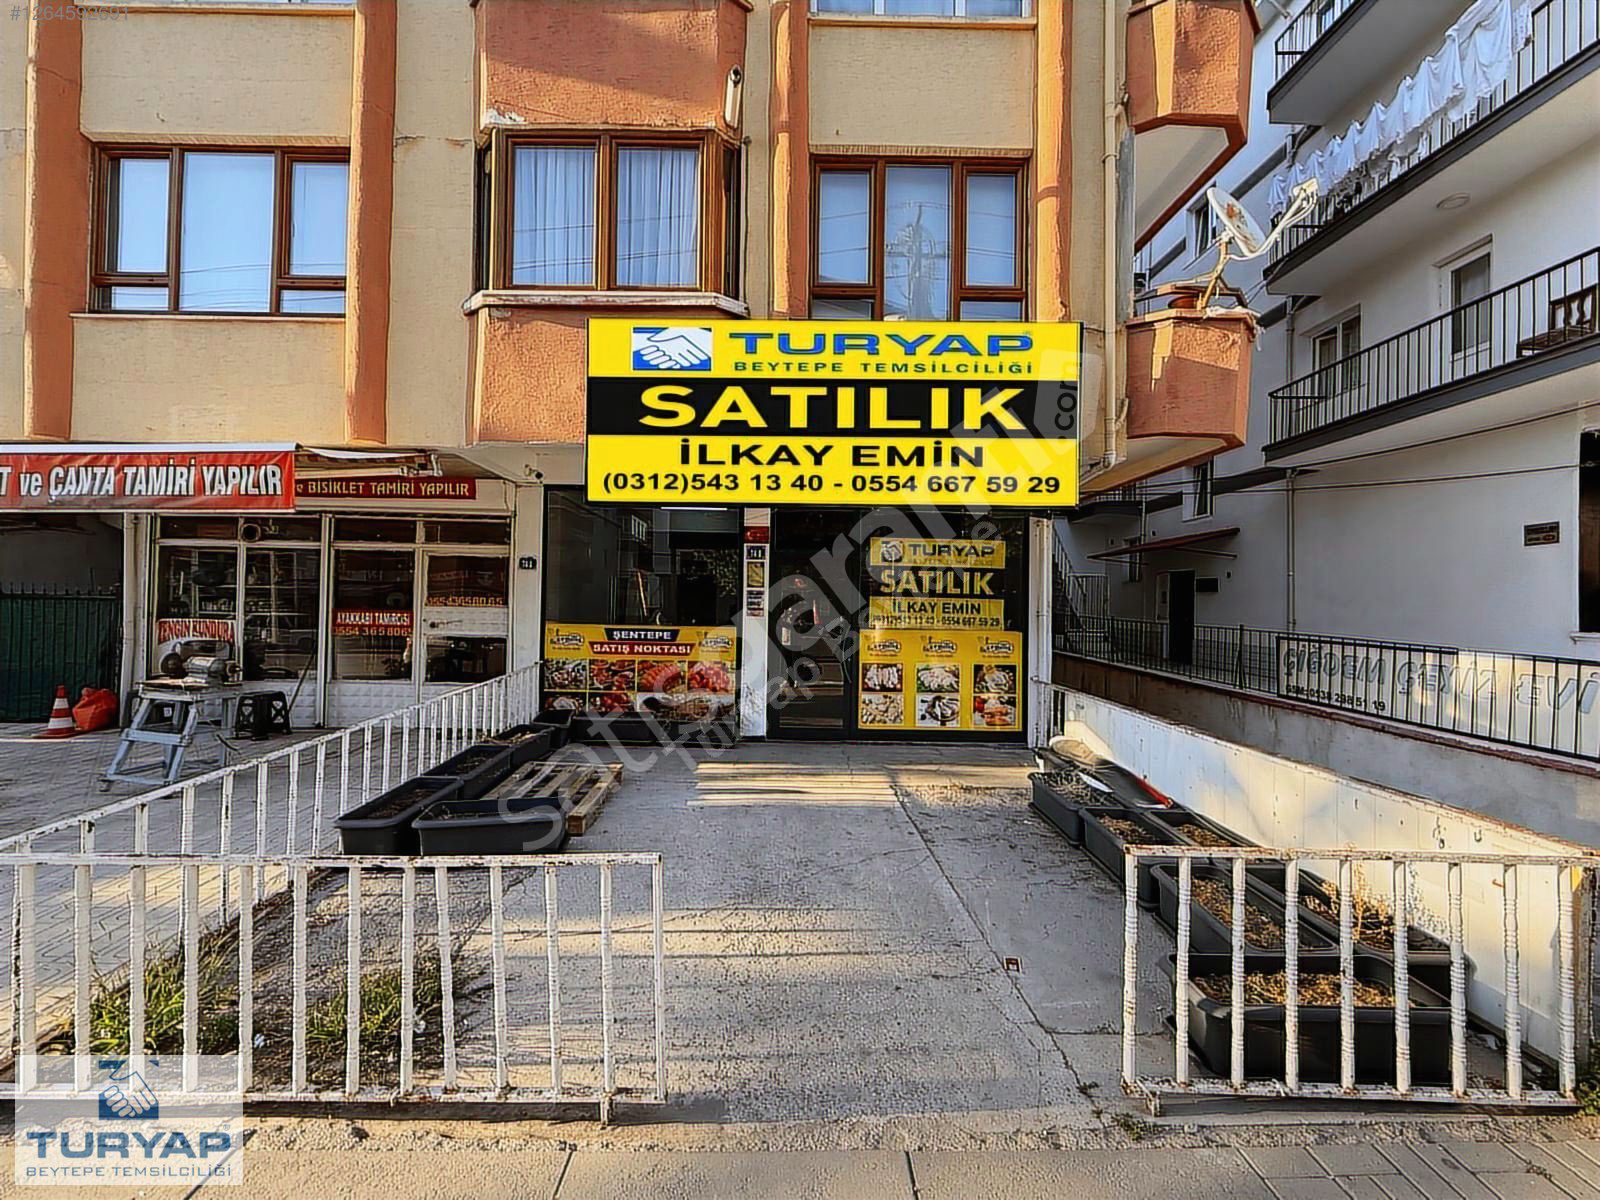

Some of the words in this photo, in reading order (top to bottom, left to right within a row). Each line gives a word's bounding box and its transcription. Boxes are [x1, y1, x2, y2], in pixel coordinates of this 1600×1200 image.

[729, 333, 1033, 356] TURYAP
[734, 361, 843, 373] BEYTEPE
[861, 359, 1032, 375] TEMSİLCİLİĞİ
[638, 385, 1027, 430] SATILIK
[680, 438, 834, 466] İLKAY
[852, 440, 984, 468] EMİN
[20, 472, 43, 496] ve
[49, 466, 115, 502] ÇANTA
[123, 458, 196, 496] TAMİRİ
[202, 464, 282, 496] YAPILIR
[419, 482, 470, 496] YAPILIR
[603, 473, 739, 494] (0312)543
[750, 474, 781, 491] 13
[791, 475, 823, 491] 40
[851, 475, 917, 492] 0554
[927, 476, 976, 492] 667
[987, 476, 1018, 493] 59
[1028, 476, 1060, 493] 29
[908, 543, 995, 557] TURYAP
[880, 569, 995, 596] SATILIK
[612, 630, 672, 641] ŞENTEPE
[593, 643, 630, 654] SATIŞ
[634, 644, 691, 654] NOKTASI
